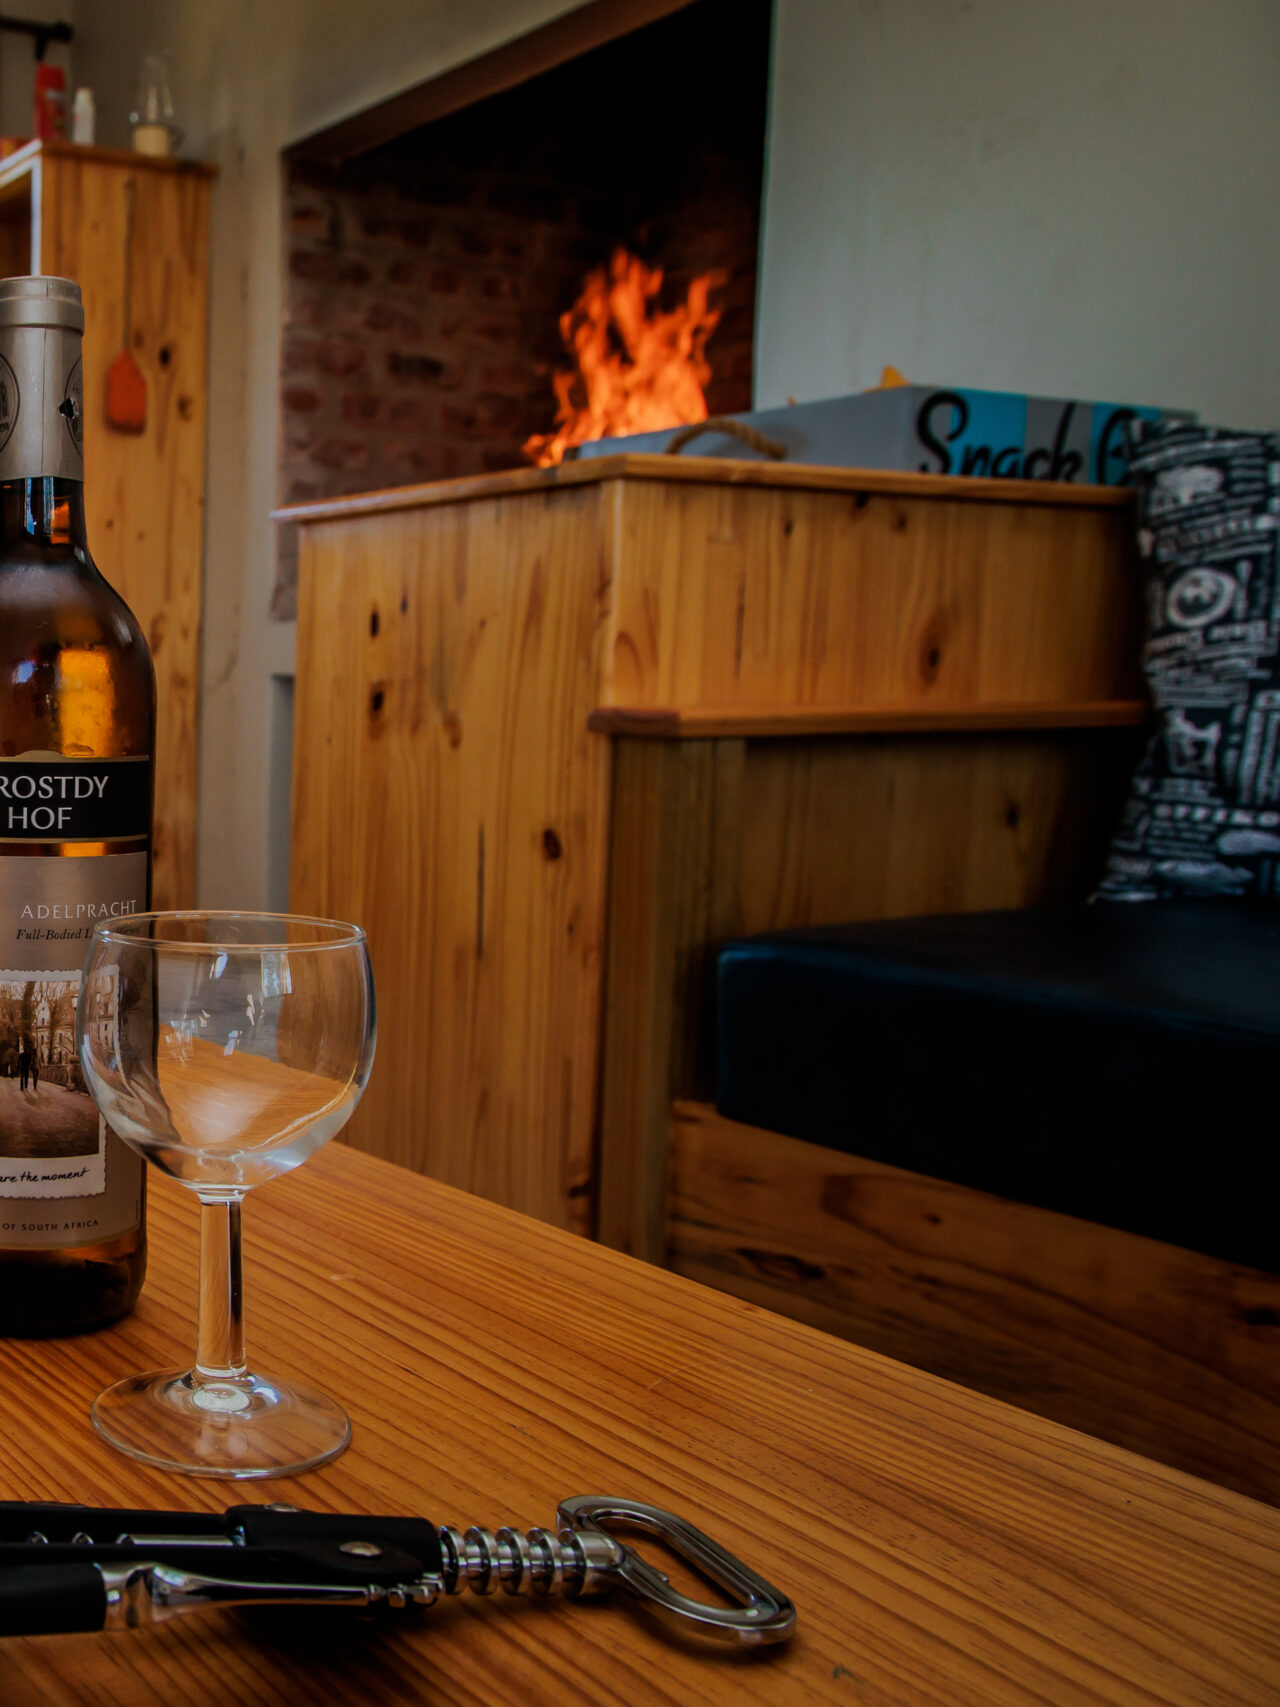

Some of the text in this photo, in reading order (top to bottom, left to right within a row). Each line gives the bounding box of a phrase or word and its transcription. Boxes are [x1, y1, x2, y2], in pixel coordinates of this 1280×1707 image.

[8, 807, 73, 830] HOF
[21, 900, 137, 919] ADELPRACHT
[16, 928, 81, 941] Full-Bodied
[20, 1171, 39, 1182] the
[41, 1166, 90, 1181] moment
[2, 1222, 16, 1231] OF
[21, 1223, 58, 1232] SOUTH
[63, 1219, 99, 1230] AFRICA
